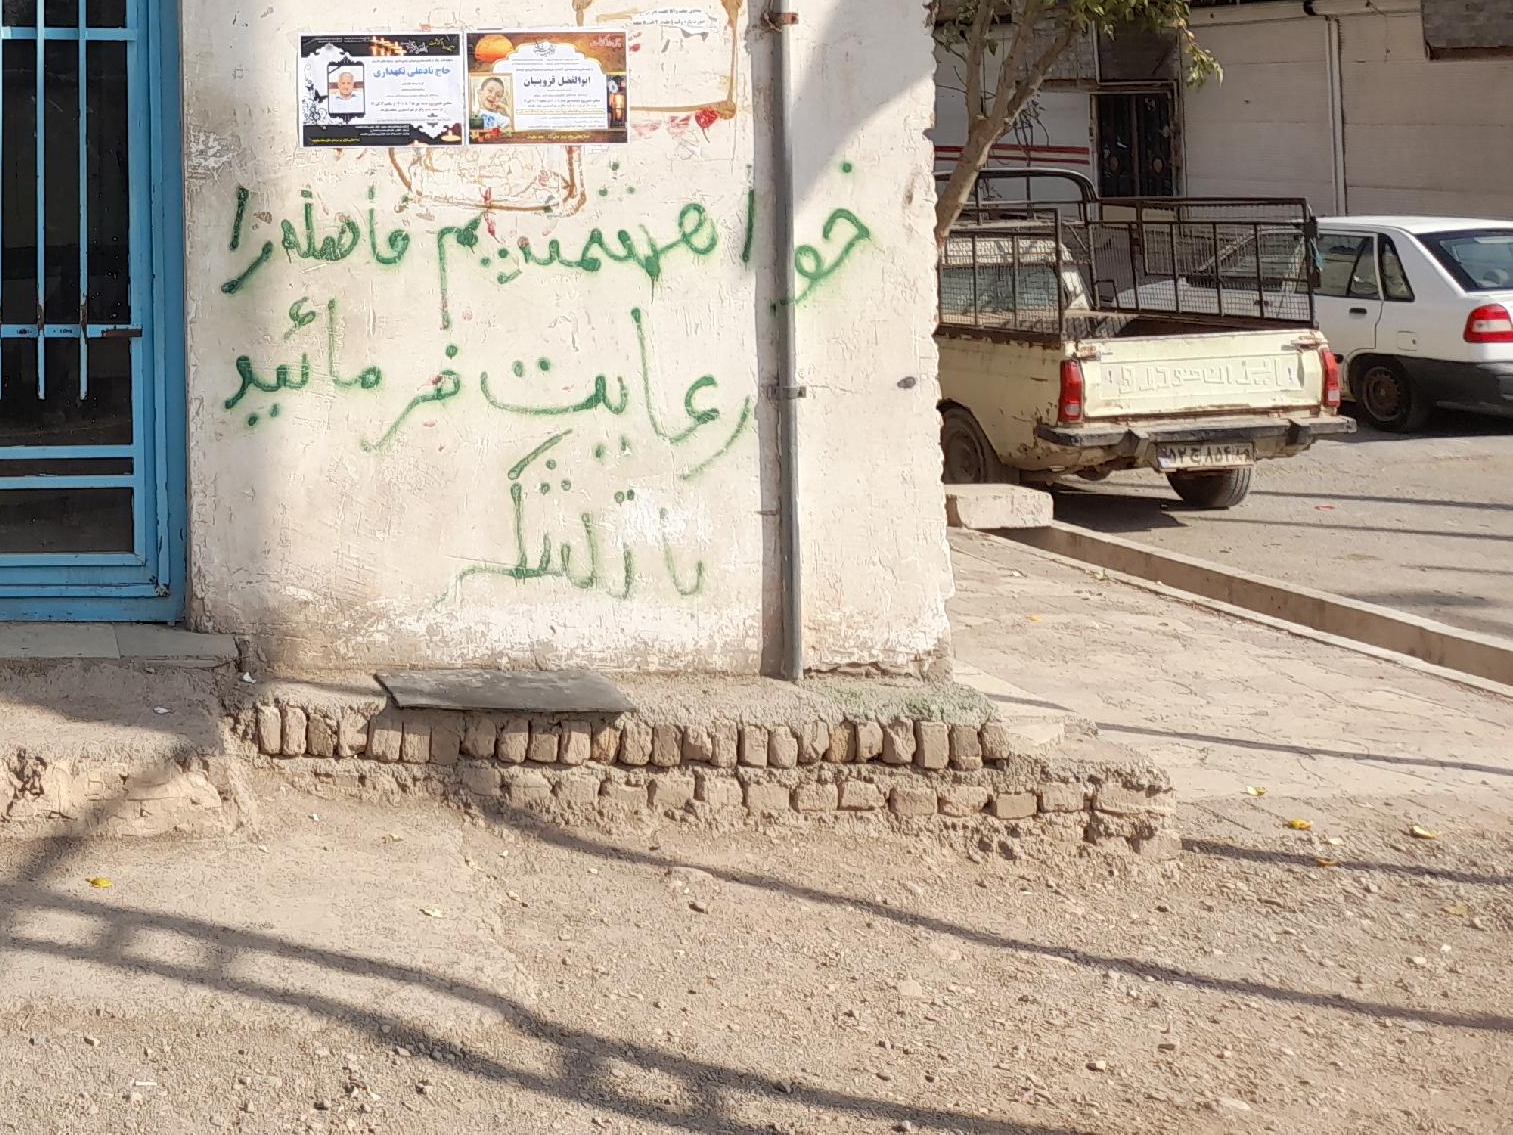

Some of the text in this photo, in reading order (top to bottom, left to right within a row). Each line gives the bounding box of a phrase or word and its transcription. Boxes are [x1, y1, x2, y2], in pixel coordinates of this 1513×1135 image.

[435, 65, 450, 78] حاج
[557, 75, 591, 87] ابوالفضل
[480, 306, 752, 482] رعایت
